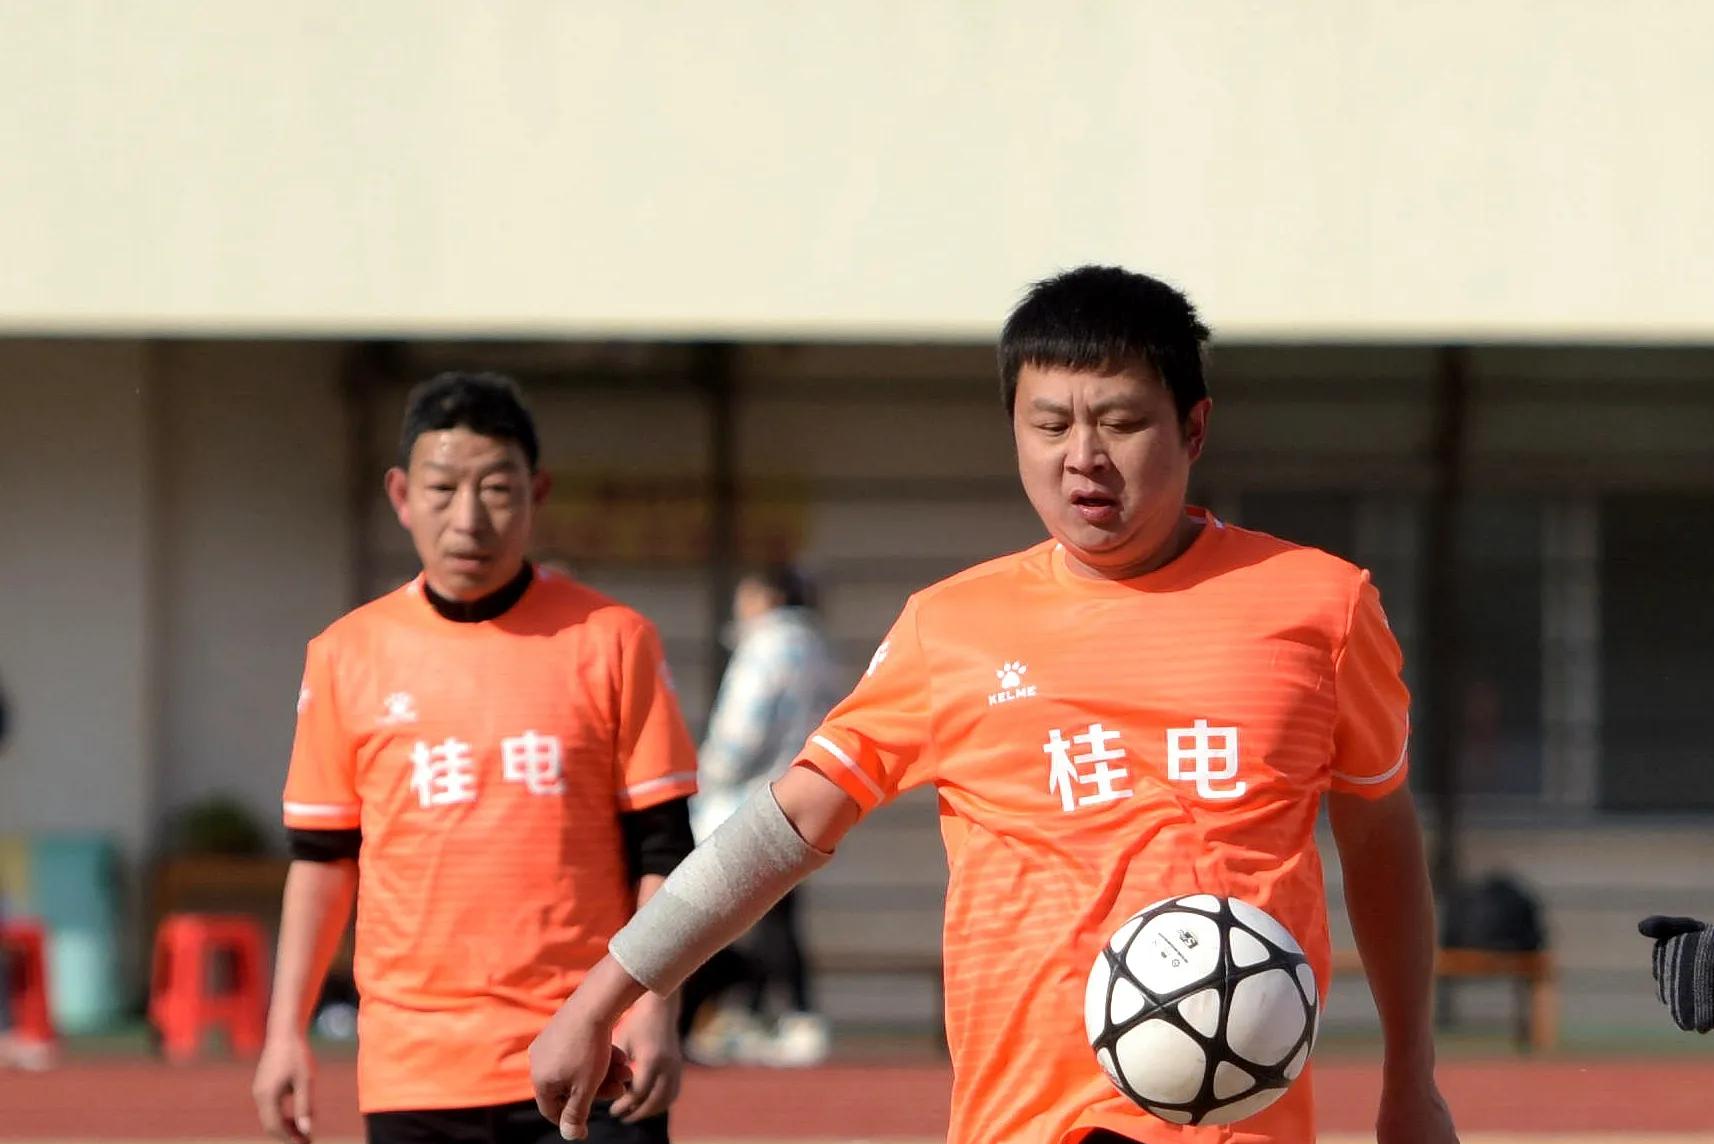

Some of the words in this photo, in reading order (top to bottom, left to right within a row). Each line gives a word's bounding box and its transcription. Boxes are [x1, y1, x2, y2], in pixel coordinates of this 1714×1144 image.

[988, 685, 1038, 706] KELME
[410, 729, 566, 809] 桂电
[1043, 719, 1246, 812] 桂电
